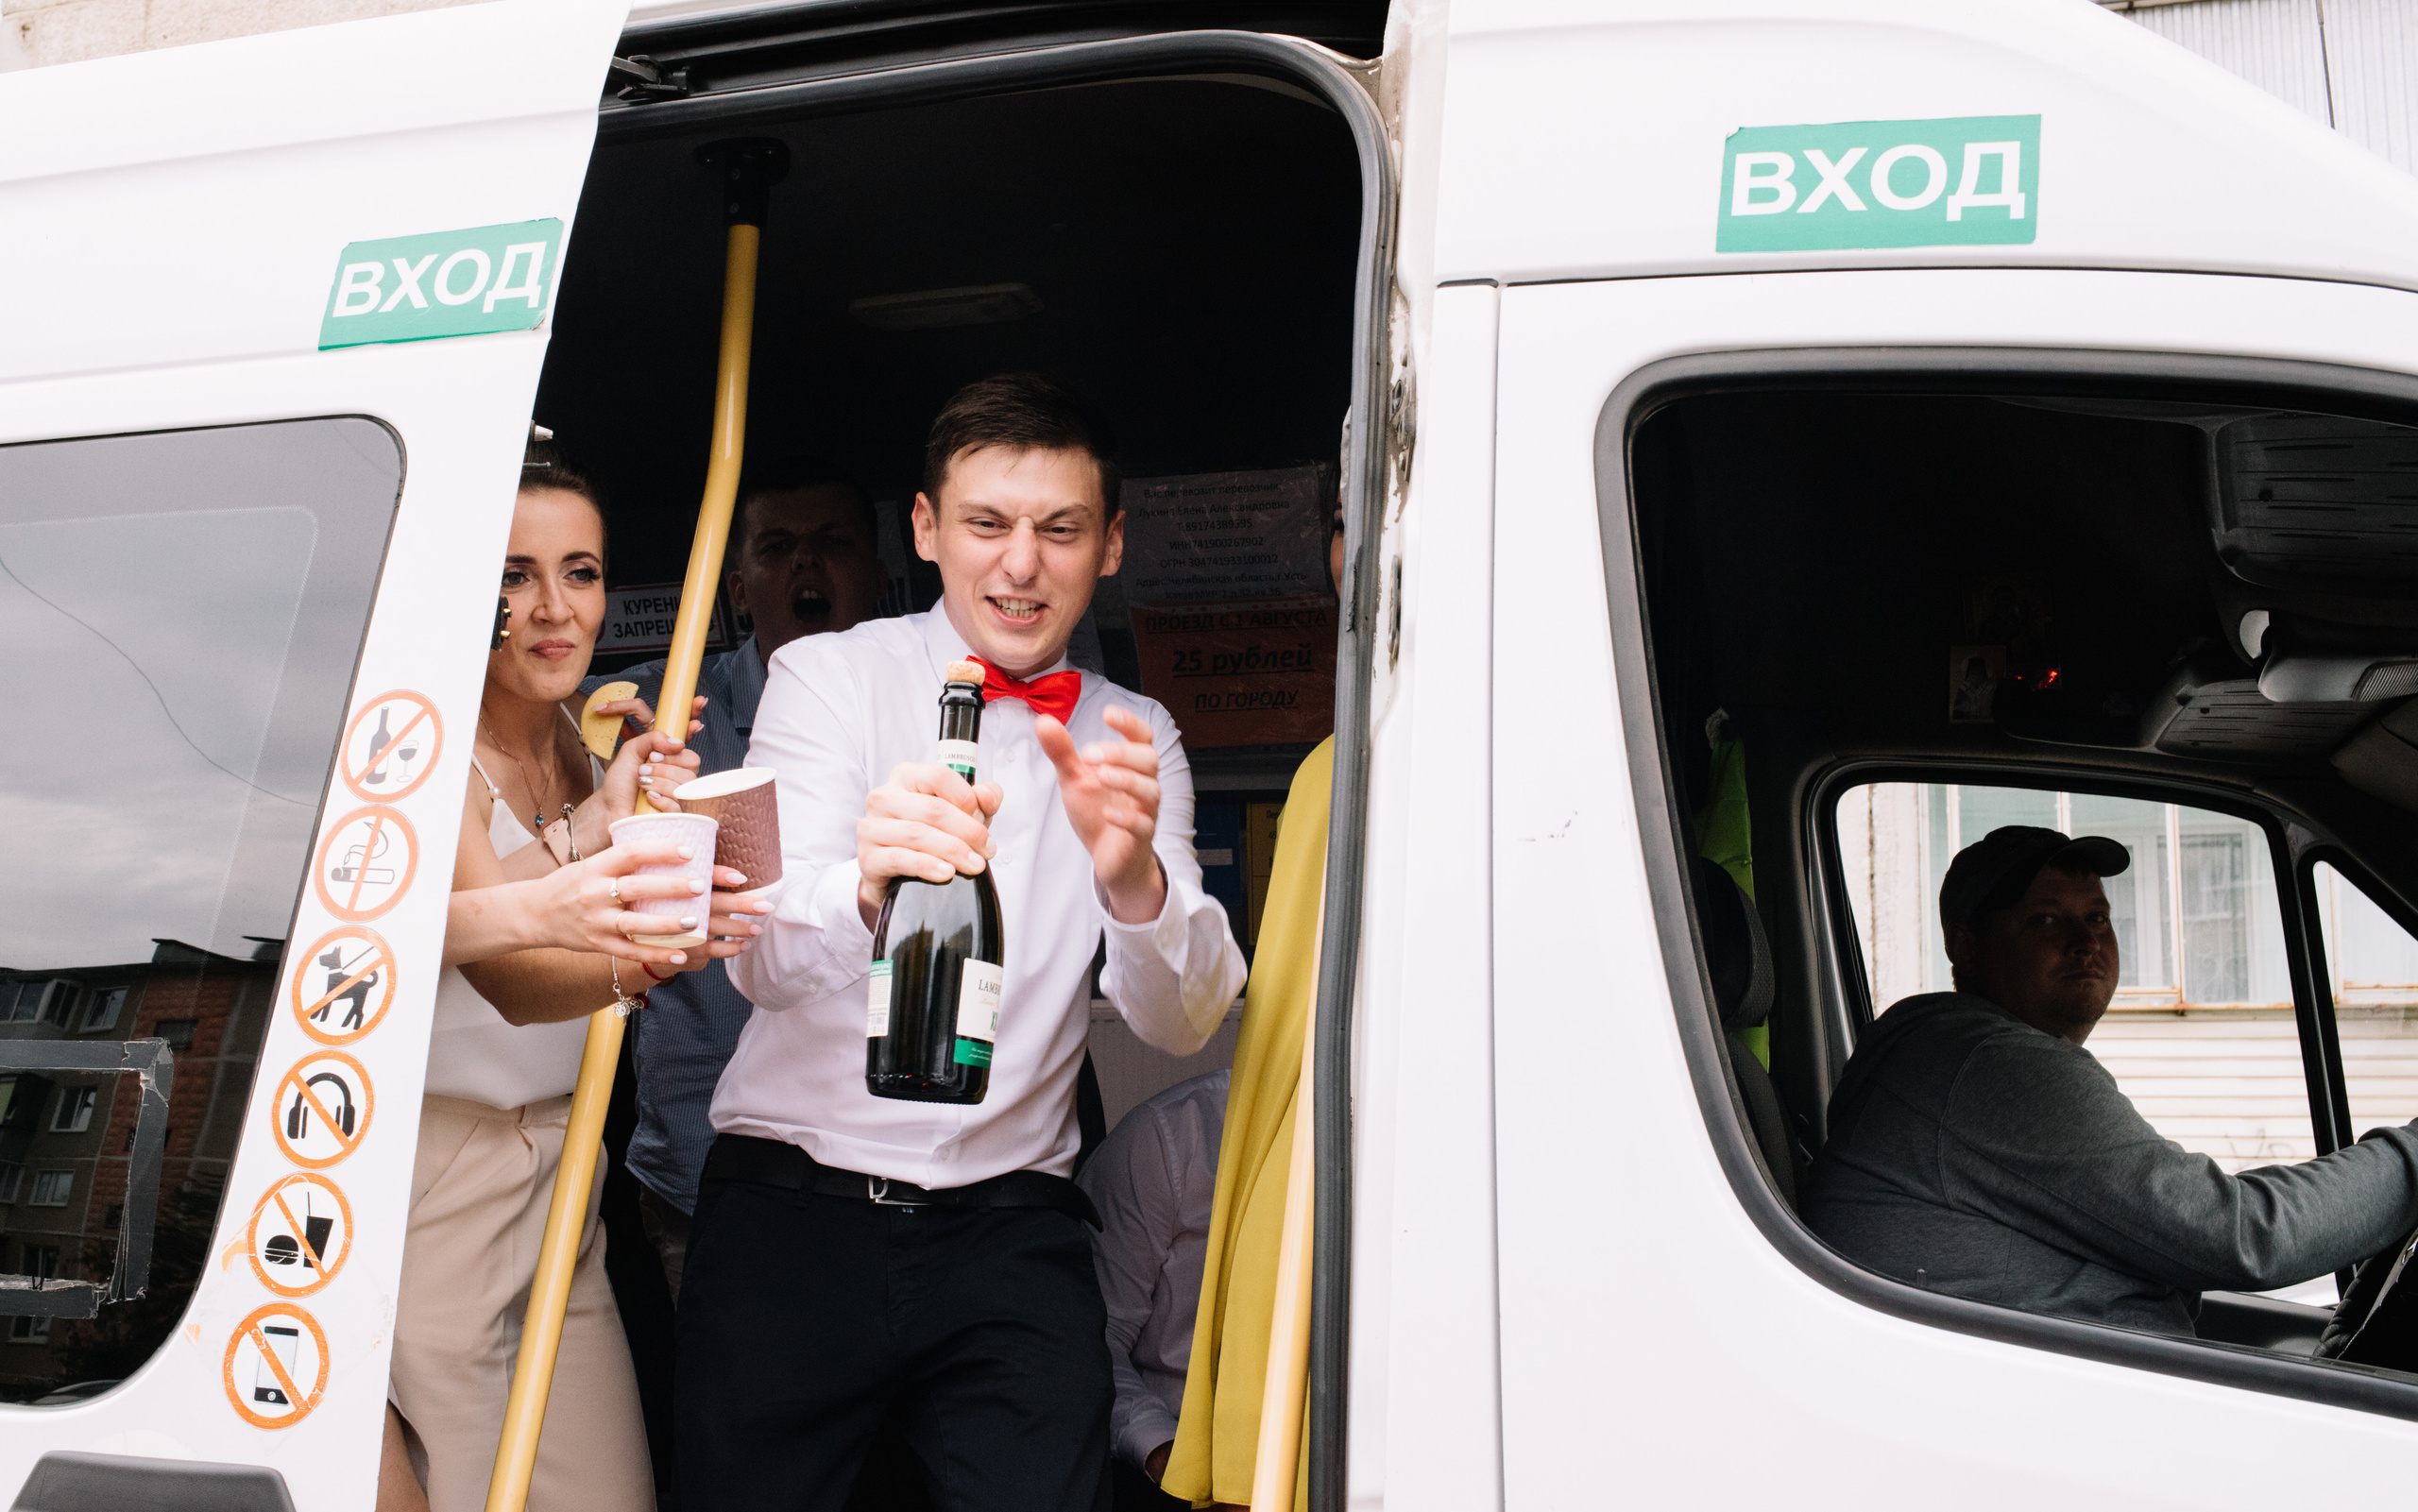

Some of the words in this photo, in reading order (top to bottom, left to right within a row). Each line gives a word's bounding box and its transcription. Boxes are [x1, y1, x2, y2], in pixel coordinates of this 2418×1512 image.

[1729, 140, 2027, 223] ВХОД
[332, 240, 548, 318] ВХОД
[1160, 558, 1186, 569] ОГРН
[623, 595, 681, 615] КУРЕНИ
[1146, 614, 1214, 631] ПРОЕЗД
[1219, 614, 1230, 627] С
[1236, 615, 1242, 626] 1
[1251, 609, 1328, 626] АВГУСТА
[1172, 649, 1203, 672] 25
[1212, 642, 1313, 674] рублей
[1195, 693, 1221, 709] ПО
[1226, 689, 1299, 708] ГОРОДУ
